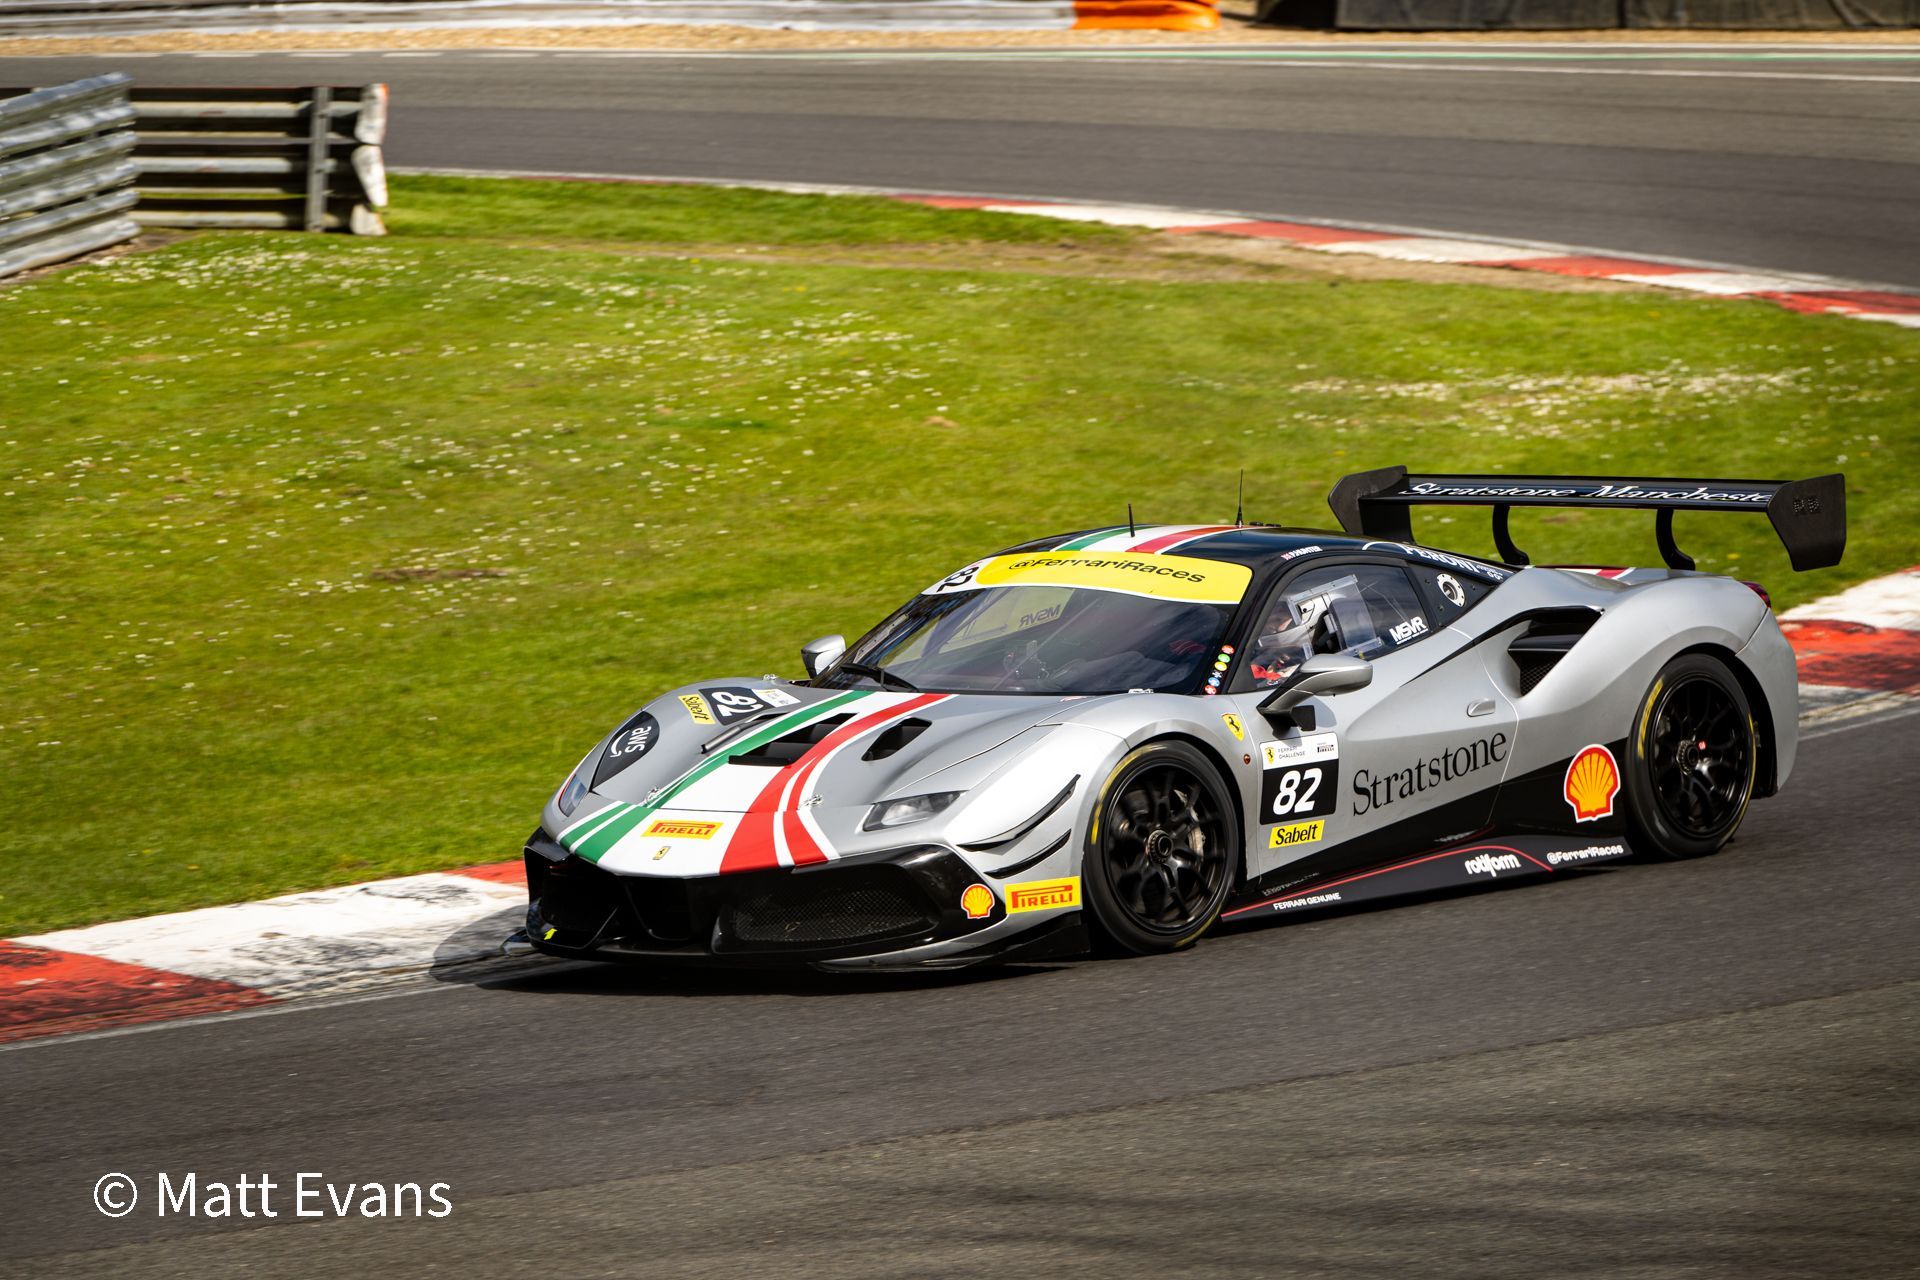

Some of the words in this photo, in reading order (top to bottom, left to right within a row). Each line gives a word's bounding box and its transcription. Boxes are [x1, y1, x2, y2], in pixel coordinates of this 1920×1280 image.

[1399, 482, 1577, 497] Stratstone
[1581, 485, 1773, 502] Mancheste
[1008, 558, 1207, 584] @FerrariRaces
[1388, 615, 1428, 643] MSVR
[711, 691, 764, 717] 82
[624, 725, 652, 753] aws
[1352, 732, 1508, 817] Stratstone
[1272, 767, 1323, 816] 82
[650, 822, 716, 836] PIRELLI
[1275, 823, 1319, 846] Sabelt
[1464, 853, 1522, 878] rotiform
[1546, 844, 1625, 865] @FerrariRaces
[1010, 884, 1073, 909] PIRELLI
[1272, 898, 1307, 911] FERRARI
[1306, 891, 1342, 905] GENUINE
